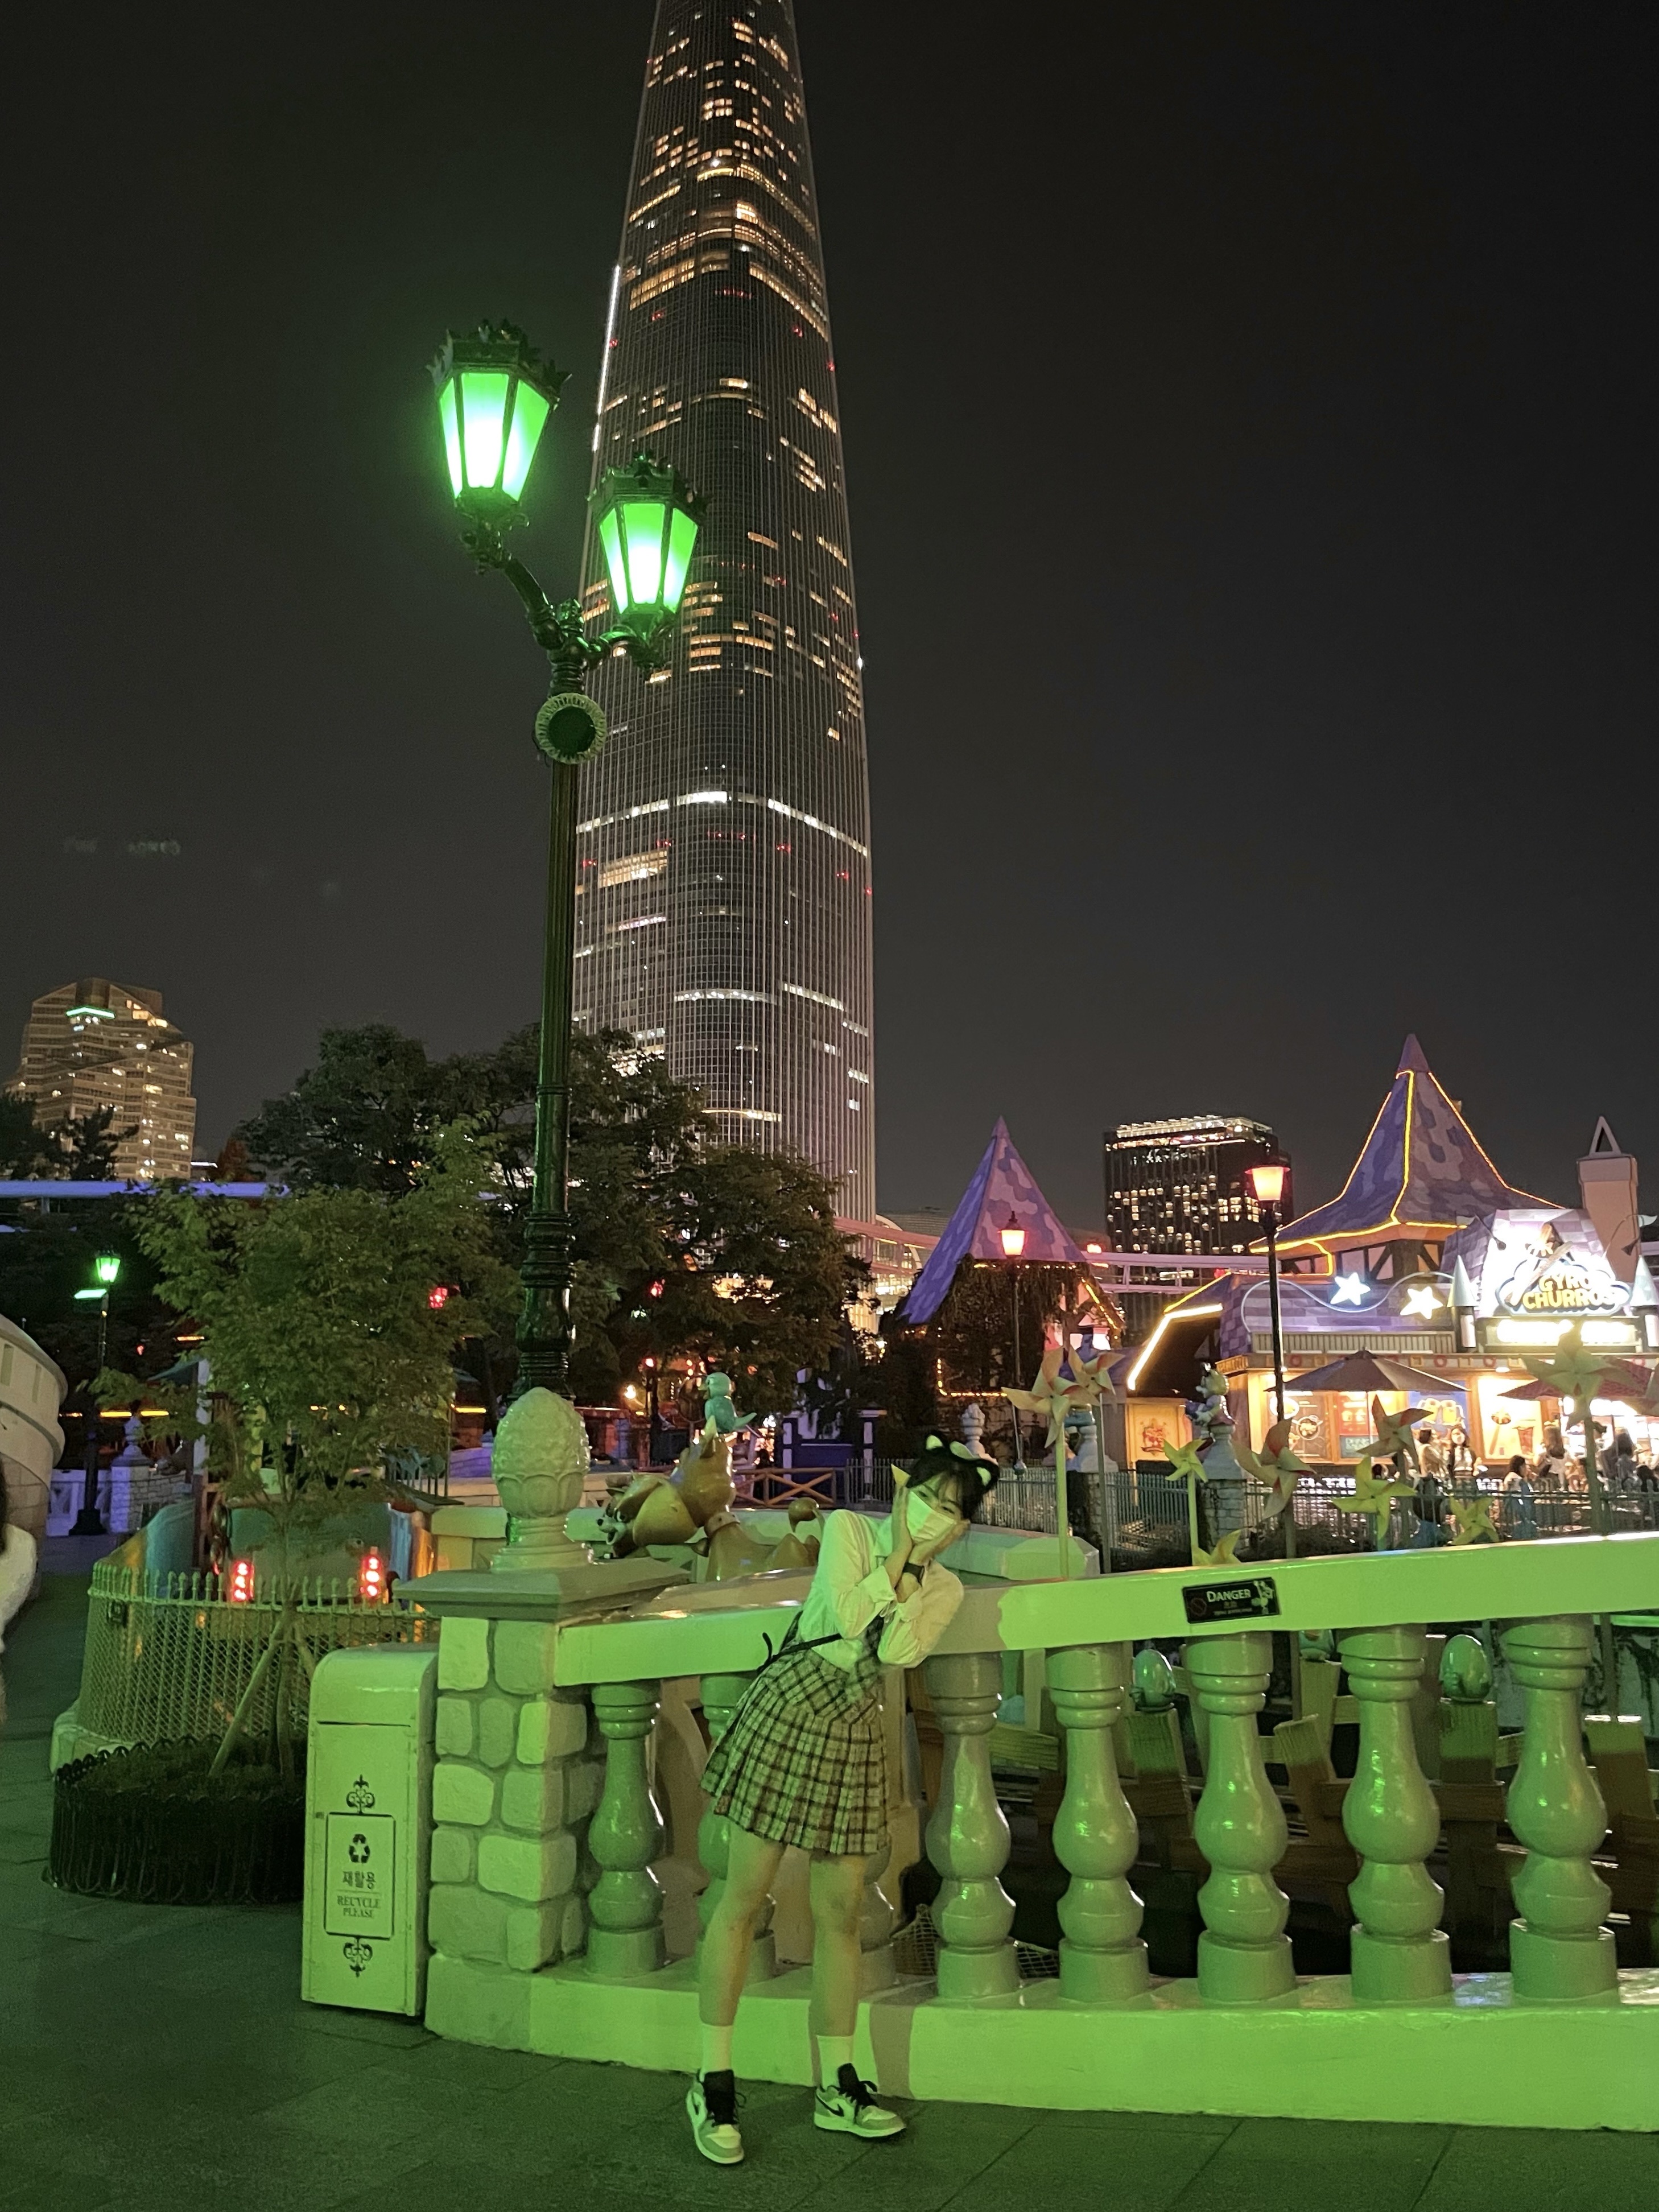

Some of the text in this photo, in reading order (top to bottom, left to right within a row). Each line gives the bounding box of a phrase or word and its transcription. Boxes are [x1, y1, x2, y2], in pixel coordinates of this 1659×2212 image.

[1522, 1287, 1616, 1310] CHURROS
[1206, 1590, 1251, 1602] DANGER
[342, 1871, 375, 1889] 재활용
[337, 1896, 380, 1908] RECYCLE
[343, 1908, 373, 1918] PLEASE
